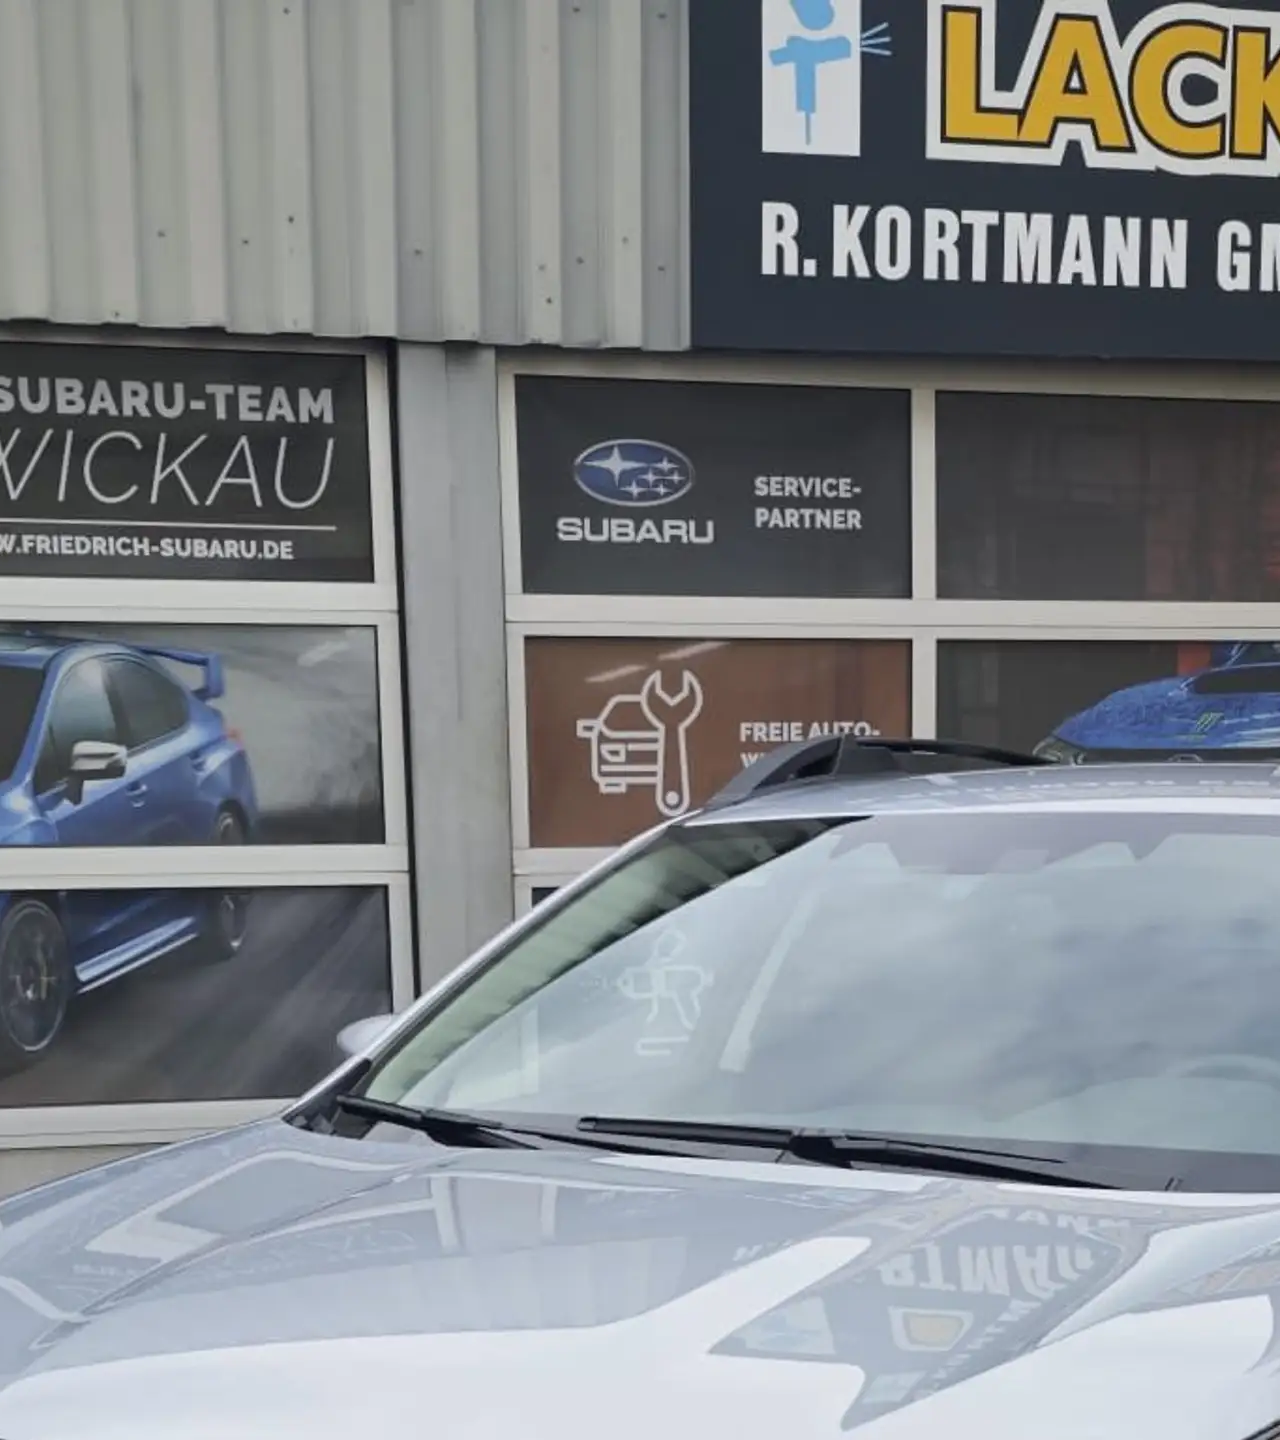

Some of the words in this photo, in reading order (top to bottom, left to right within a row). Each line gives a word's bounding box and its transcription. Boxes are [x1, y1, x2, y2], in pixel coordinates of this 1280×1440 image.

[760, 201, 817, 277] R.
[832, 204, 1189, 289] KORTMANN
[754, 475, 862, 499] SERVICE-
[556, 516, 716, 544] SUBARU
[754, 507, 863, 531] PARTNER
[739, 721, 803, 742] FREIE
